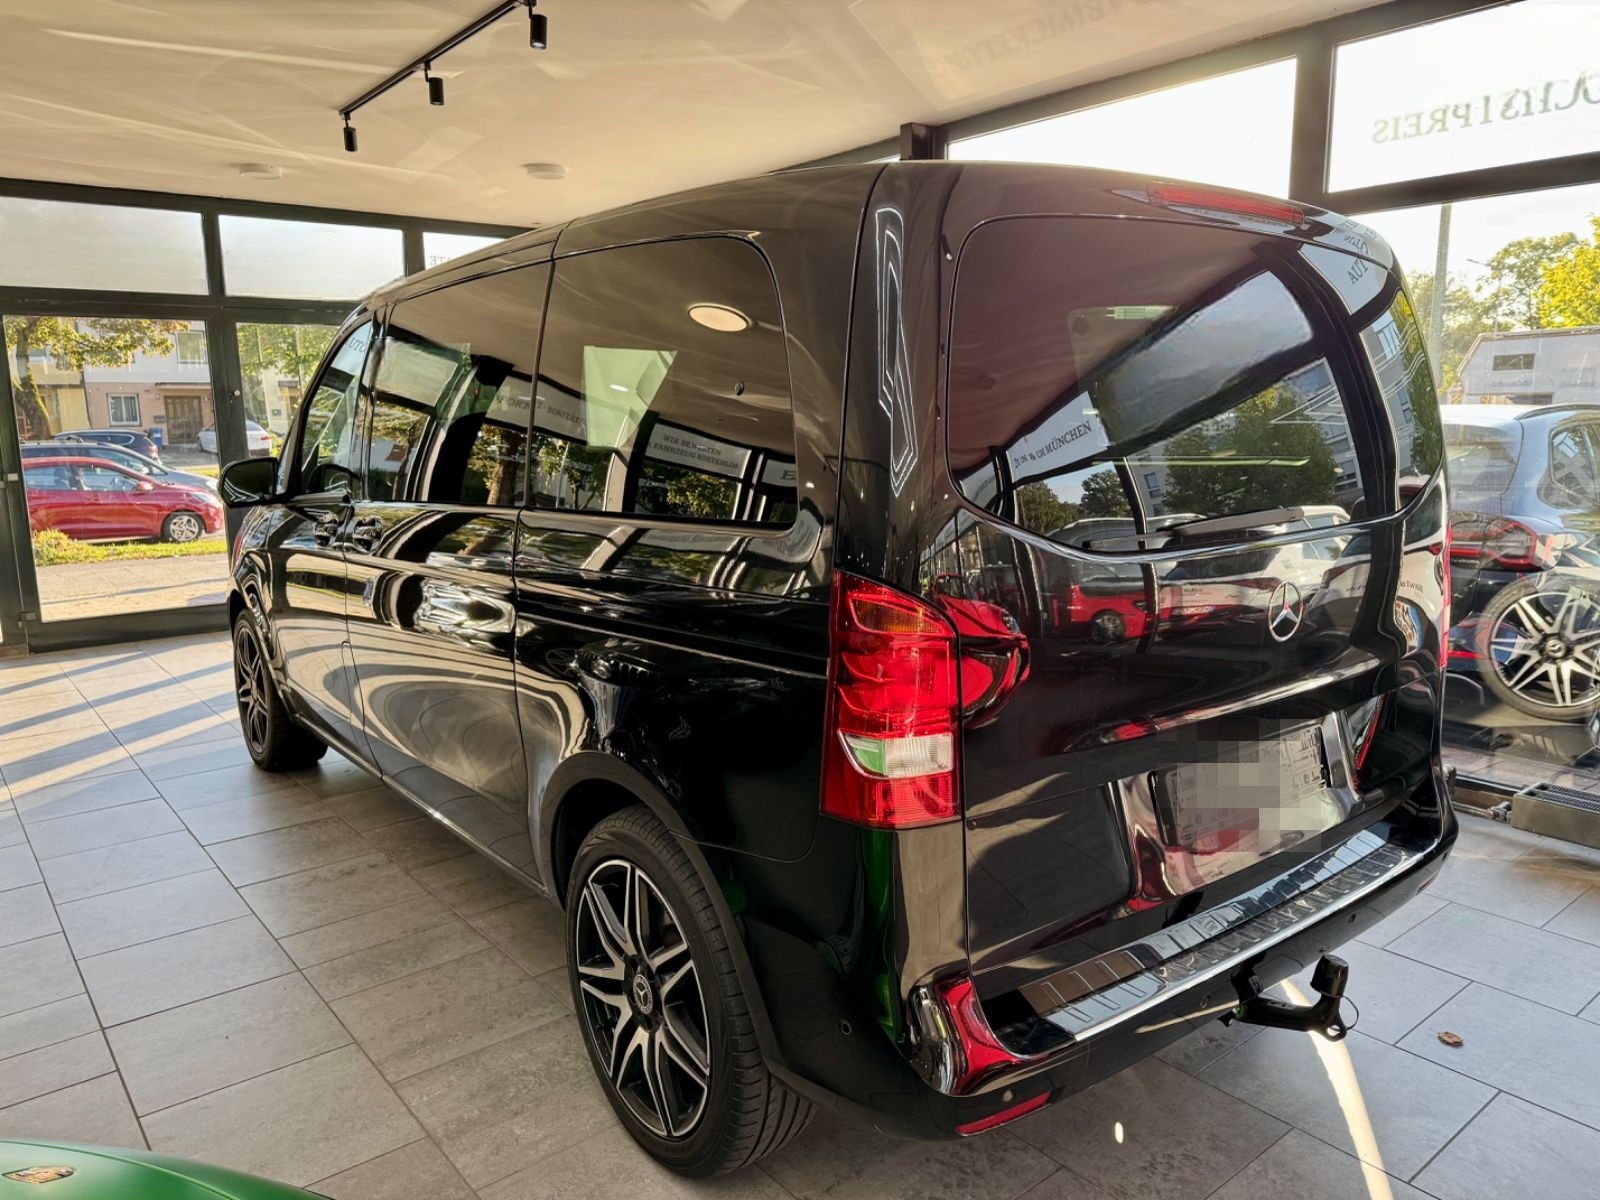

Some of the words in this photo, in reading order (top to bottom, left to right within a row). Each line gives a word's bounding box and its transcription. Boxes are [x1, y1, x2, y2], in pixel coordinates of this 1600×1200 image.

[663, 434, 679, 446] WIR
[1029, 452, 1036, 461] &
[1045, 420, 1092, 453] MÜNCHEN
